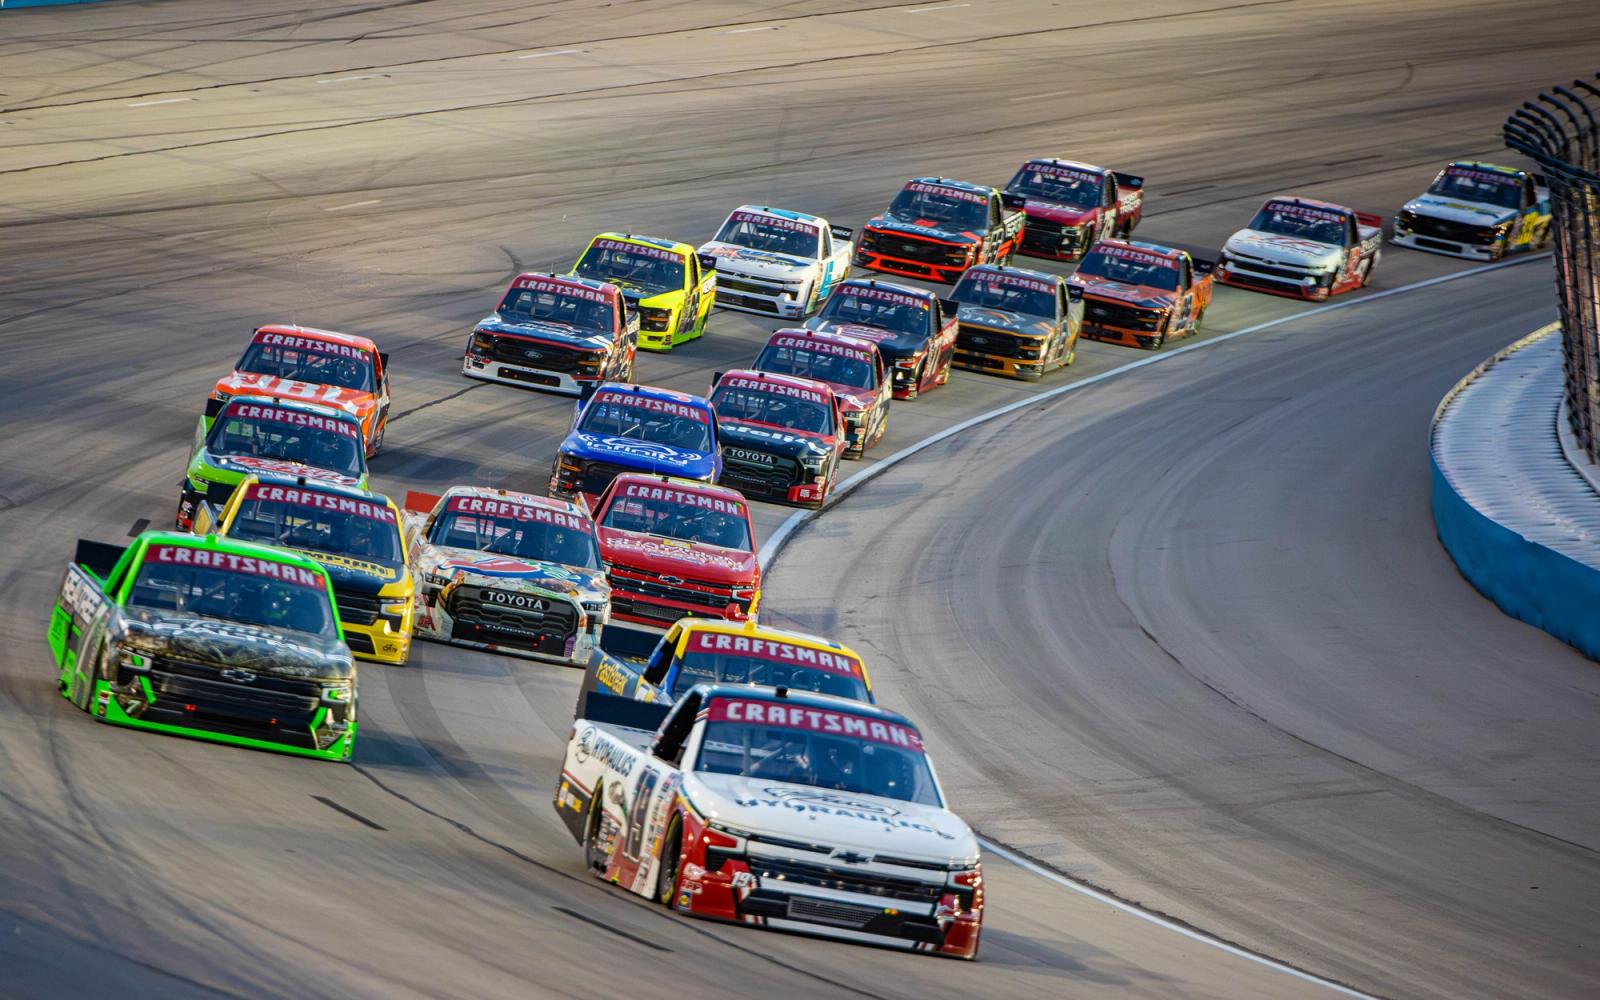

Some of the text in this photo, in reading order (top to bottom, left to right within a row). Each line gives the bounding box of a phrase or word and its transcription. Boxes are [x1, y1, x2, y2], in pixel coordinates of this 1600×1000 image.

[1027, 163, 1097, 182] CRAFTSMAN
[910, 182, 983, 203] CRAFTSMAN
[736, 213, 814, 234] CRAFTSMAN
[599, 239, 678, 261] CRAFTSMAN
[1099, 246, 1173, 268] CRAFTSMAN
[519, 279, 605, 302] CRAFTSMAN
[970, 271, 1049, 290] CRAFTSMAN
[842, 286, 923, 308] CRAFTSMAN
[263, 333, 363, 360] CRAFTSMAN
[776, 337, 864, 360] CRAFTSMAN
[728, 378, 821, 402] CRAFTSMAN
[602, 393, 700, 419] CRAFTSMAN
[238, 405, 349, 433] CRAFTSMAN
[730, 448, 773, 464] TOYOTA
[257, 486, 386, 520] CRAFTSMAN
[627, 485, 738, 515] CRAFTSMAN
[458, 498, 580, 529] CRAFTSMAN
[159, 547, 315, 586] CRAFTSMAN
[488, 591, 543, 609] TOYOTA
[700, 634, 851, 673] CRAFTSMAN
[726, 702, 909, 746] CRAFTSMAN
[732, 871, 751, 888] 19
